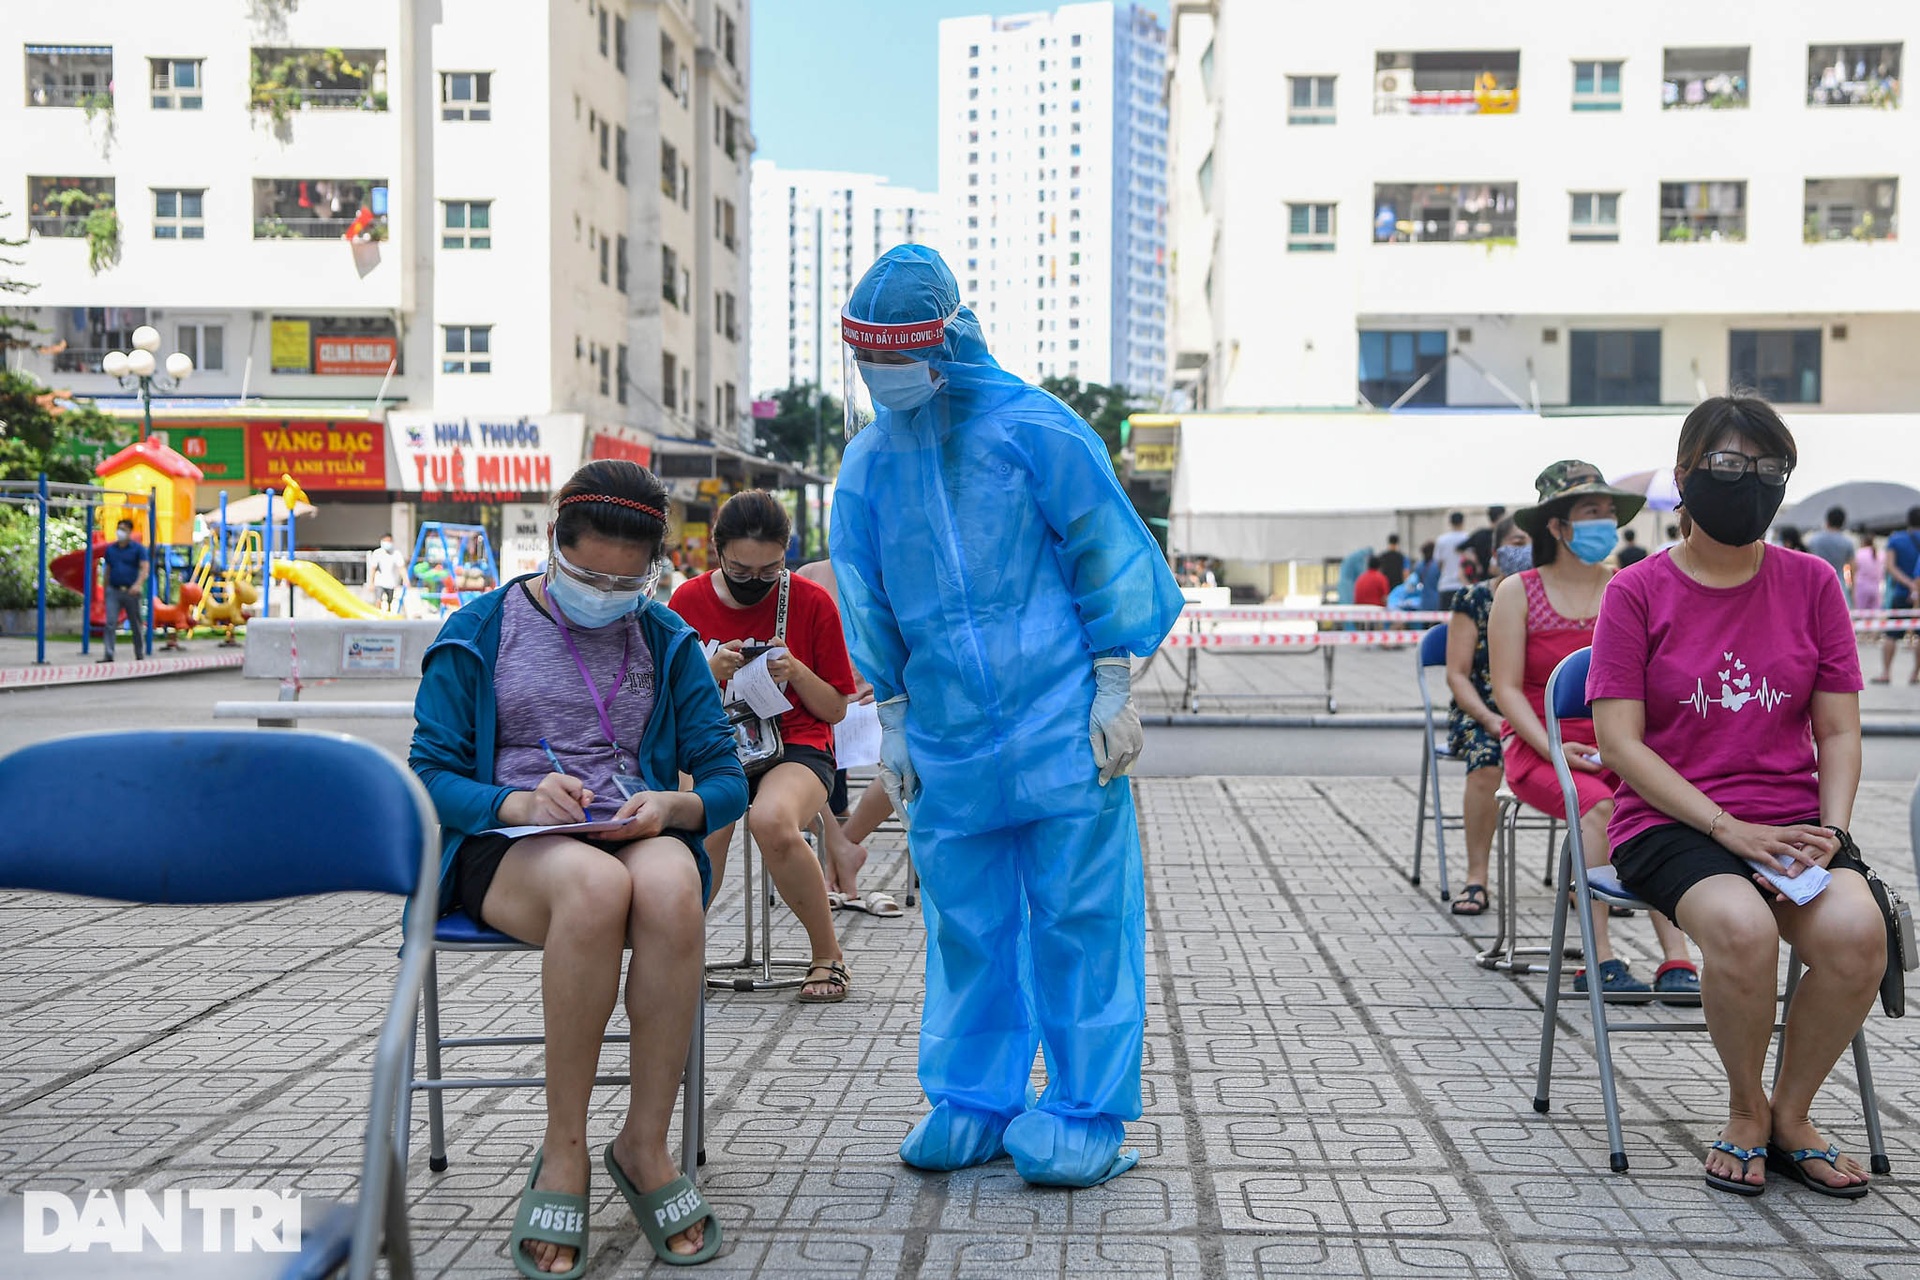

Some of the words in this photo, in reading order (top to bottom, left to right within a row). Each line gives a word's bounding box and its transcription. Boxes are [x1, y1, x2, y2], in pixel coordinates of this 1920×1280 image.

[860, 331, 874, 344] TAY
[895, 330, 909, 344] LÙI
[352, 344, 391, 362] ENGLISH
[262, 427, 323, 453] VÀNG
[327, 431, 373, 459] BẠC
[434, 416, 472, 447] NHÀ
[480, 414, 540, 448] THUỐC
[477, 454, 550, 484] MINH
[529, 1206, 584, 1232] POSEE
